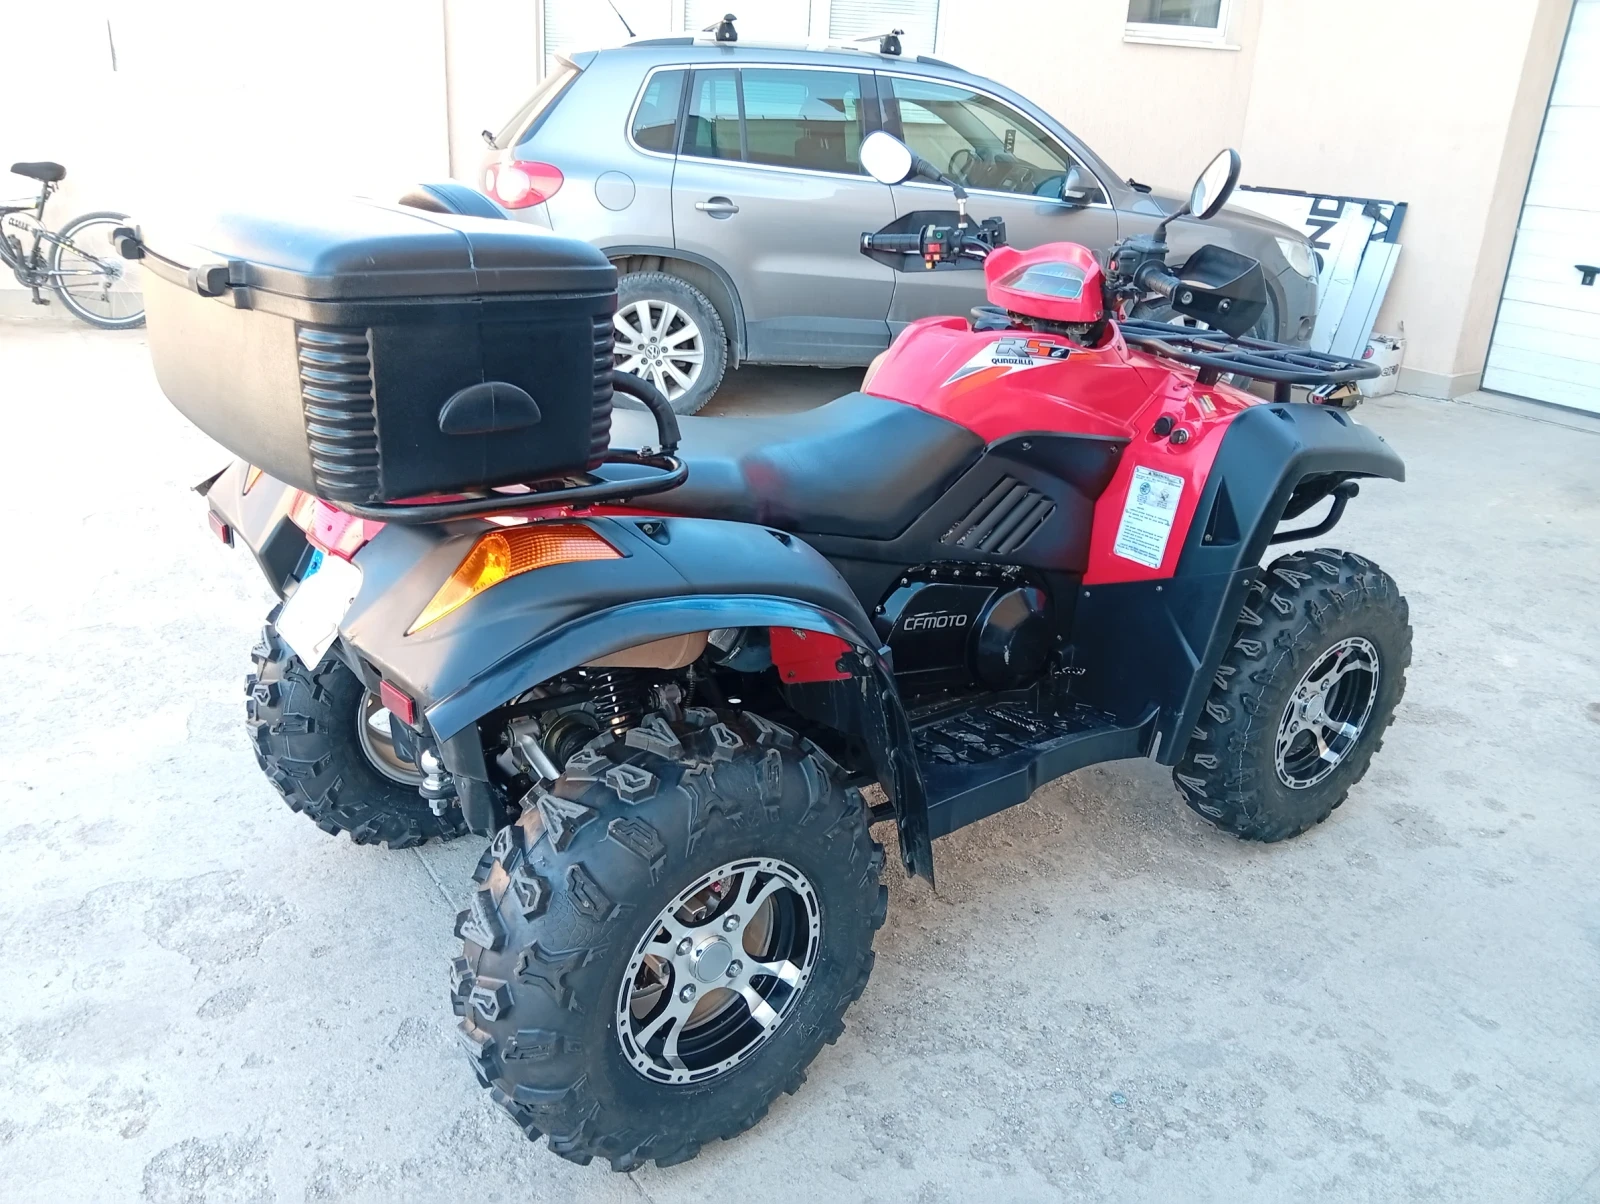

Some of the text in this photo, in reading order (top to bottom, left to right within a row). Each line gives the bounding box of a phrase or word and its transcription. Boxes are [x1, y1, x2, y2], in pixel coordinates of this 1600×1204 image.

[1006, 133, 1014, 150] VIP
[991, 357, 1034, 366] QUADZILLA
[903, 614, 968, 631] CFMOTO
